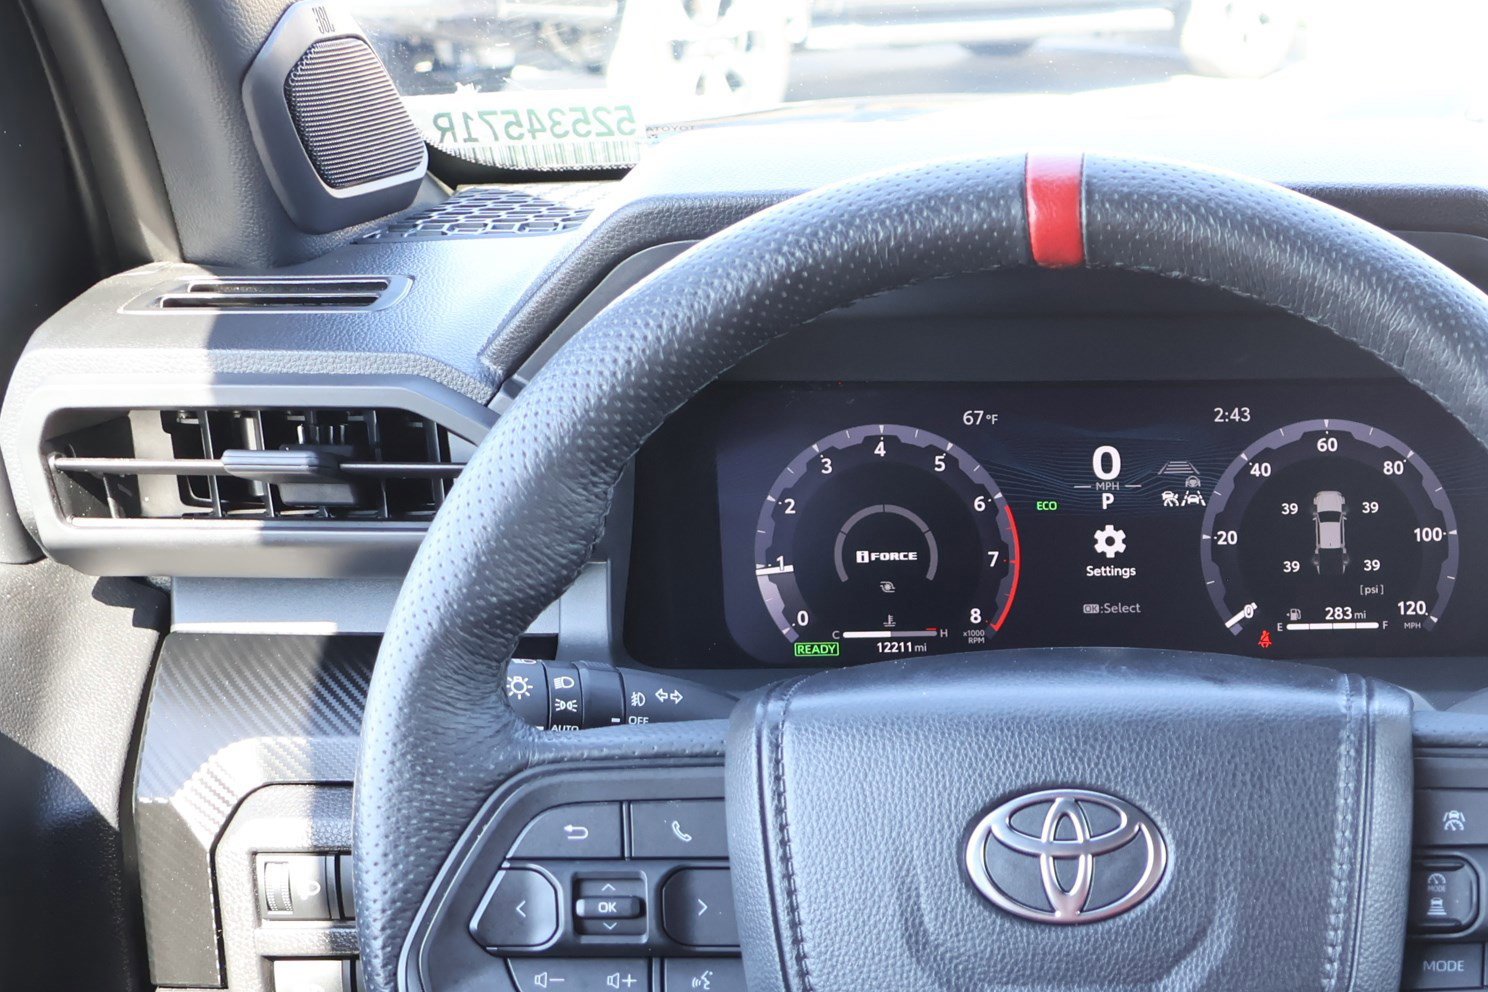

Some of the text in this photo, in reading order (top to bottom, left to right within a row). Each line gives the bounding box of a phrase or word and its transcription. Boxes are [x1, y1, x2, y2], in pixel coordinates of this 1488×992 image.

[1213, 407, 1251, 423] 2:43
[874, 440, 887, 457] 4
[1316, 437, 1338, 453] 60
[821, 458, 833, 475] 3
[934, 455, 946, 473] 5
[1091, 445, 1122, 481] 0
[1250, 462, 1272, 478] 40
[1382, 460, 1404, 476] 80
[1095, 482, 1120, 491] MPH
[784, 498, 796, 515] 2
[973, 495, 986, 512] 6
[1036, 500, 1058, 512] ECO
[1101, 493, 1115, 510] P
[1281, 503, 1299, 515] 39
[1361, 501, 1379, 514] 39
[1216, 530, 1238, 546] 20
[1413, 527, 1443, 542] 100
[987, 551, 1000, 567] 7
[1363, 559, 1381, 572] 39
[1086, 564, 1137, 580] Settings
[1283, 561, 1300, 574] 39
[969, 608, 982, 625] 8
[1324, 607, 1367, 621] 283 mi
[1397, 602, 1426, 617] 120
[797, 610, 809, 627] 0
[1382, 620, 1389, 631] F
[1403, 621, 1421, 630] MPH
[939, 629, 949, 639] H
[1277, 622, 1283, 632] E
[832, 631, 840, 640] C
[797, 644, 837, 656] READY
[876, 641, 927, 654] 12211 mi
[628, 715, 649, 725] OFF
[598, 902, 617, 914] OK
[1423, 959, 1465, 973] MODE
